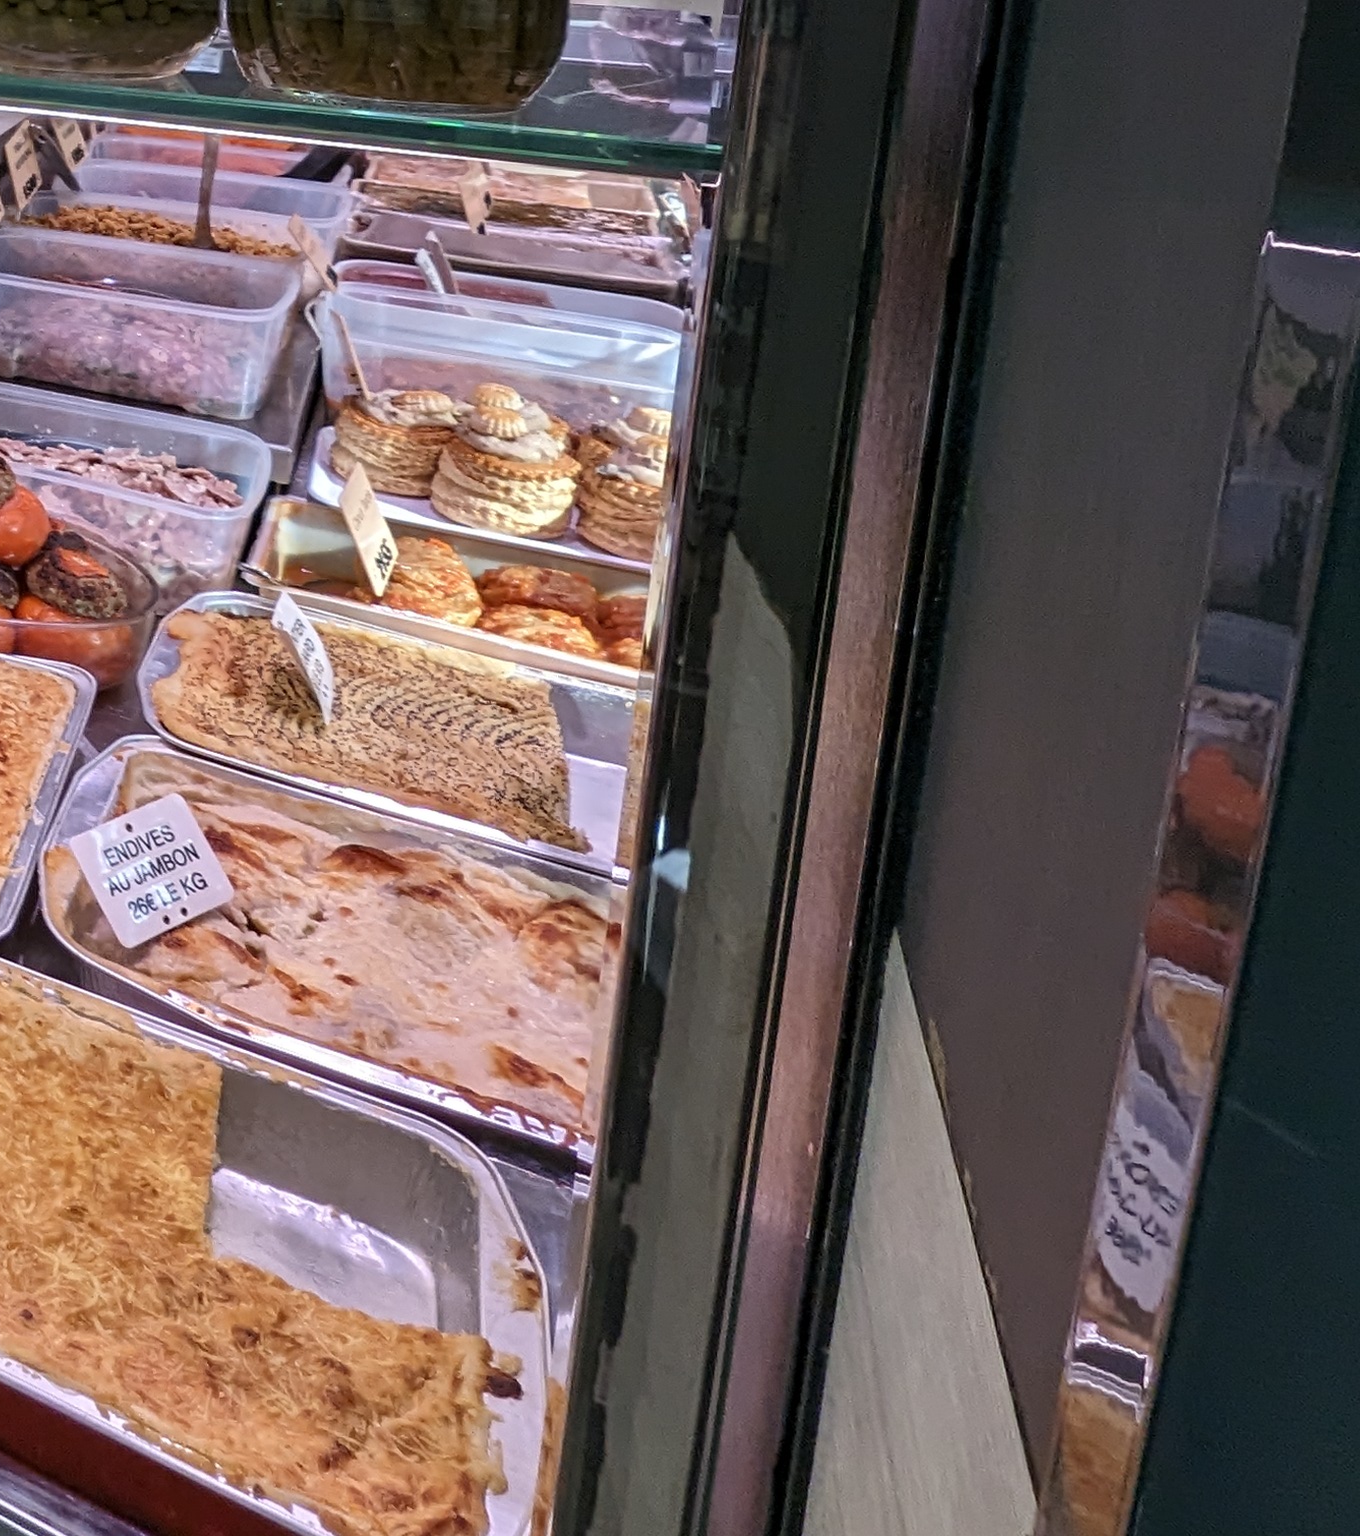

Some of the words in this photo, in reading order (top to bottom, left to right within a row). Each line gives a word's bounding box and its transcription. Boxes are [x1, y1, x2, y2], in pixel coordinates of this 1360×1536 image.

[103, 825, 176, 867] ENDIVES
[108, 873, 130, 897] AU
[134, 843, 201, 885] JAMBON
[127, 893, 158, 920] 26€
[156, 882, 181, 907] LE
[179, 871, 208, 896] KG
